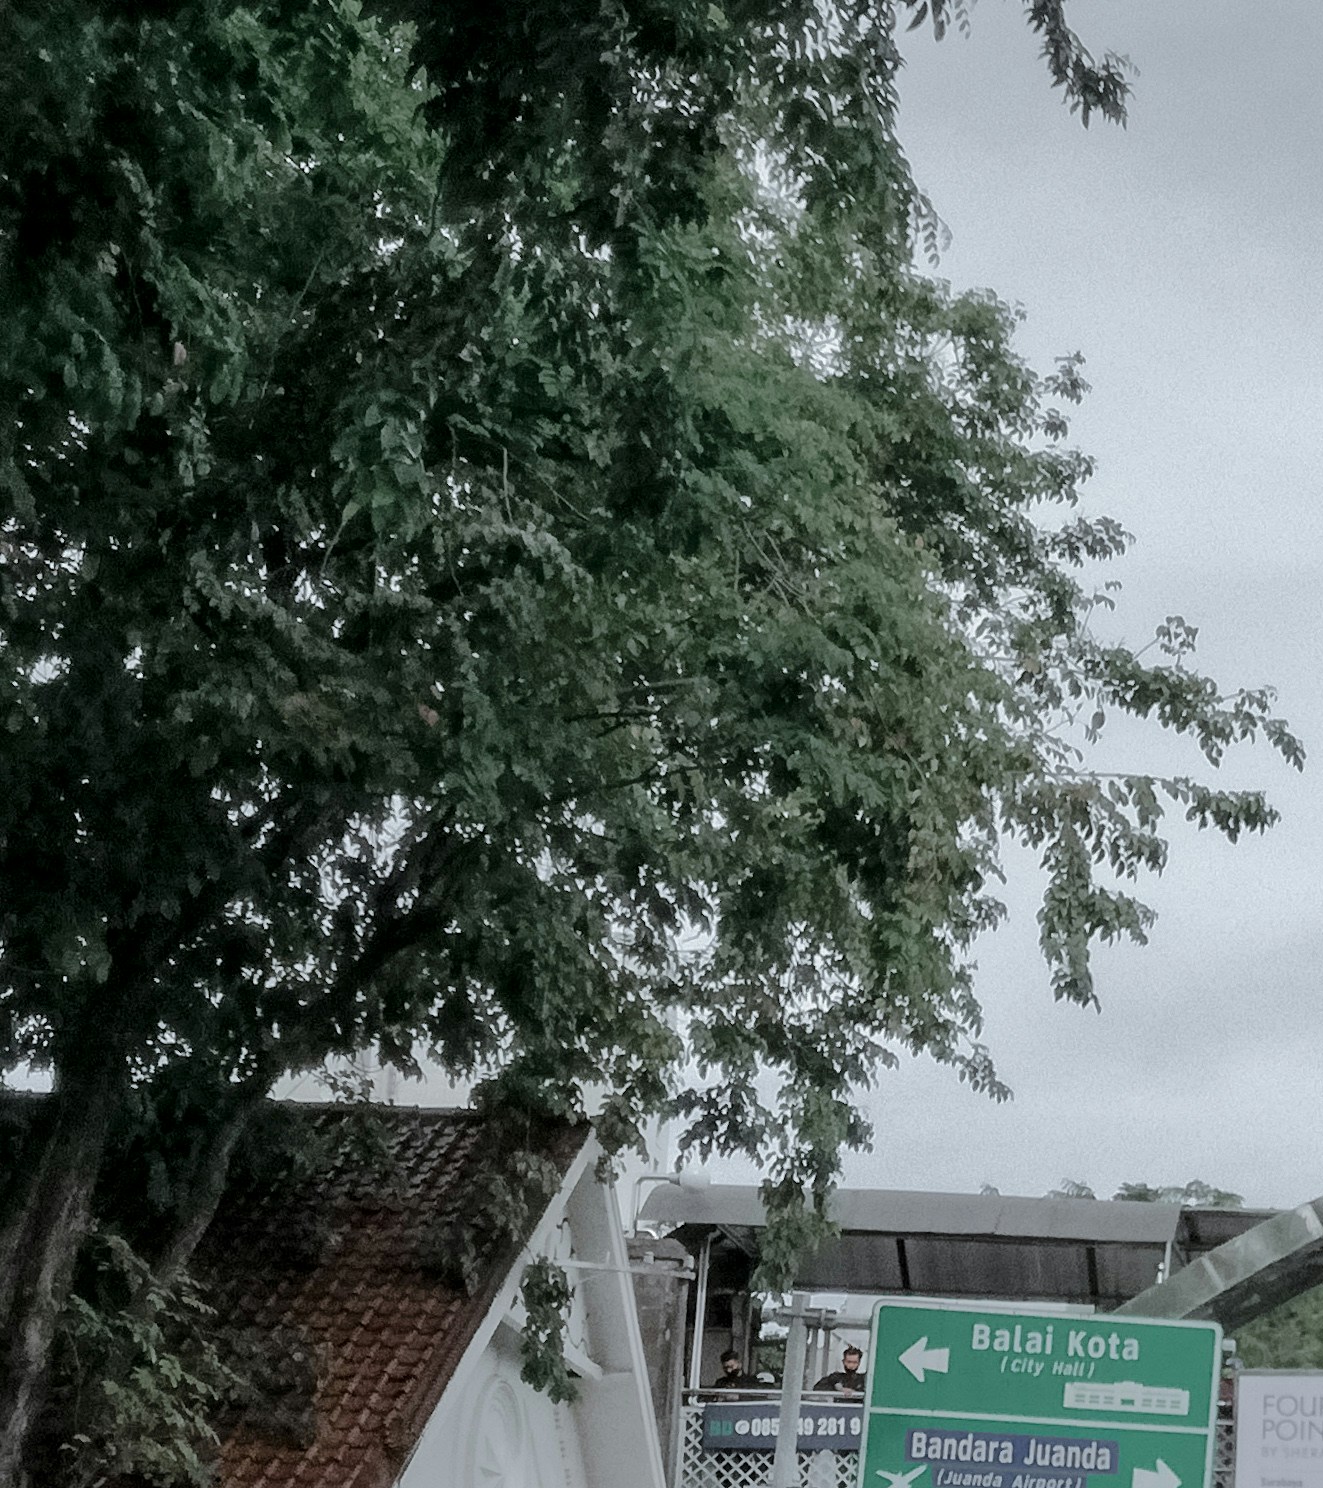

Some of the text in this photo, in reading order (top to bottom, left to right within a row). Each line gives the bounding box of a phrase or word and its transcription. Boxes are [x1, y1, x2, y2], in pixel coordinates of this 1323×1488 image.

[972, 1323, 1140, 1361] Balai Kota
[1000, 1356, 1095, 1380] (City Hall)
[817, 1417, 846, 1436] 281
[911, 1431, 1111, 1471] Bandara Juanda
[1261, 1446, 1278, 1459] BY
[937, 1468, 1003, 1488] (Juanda
